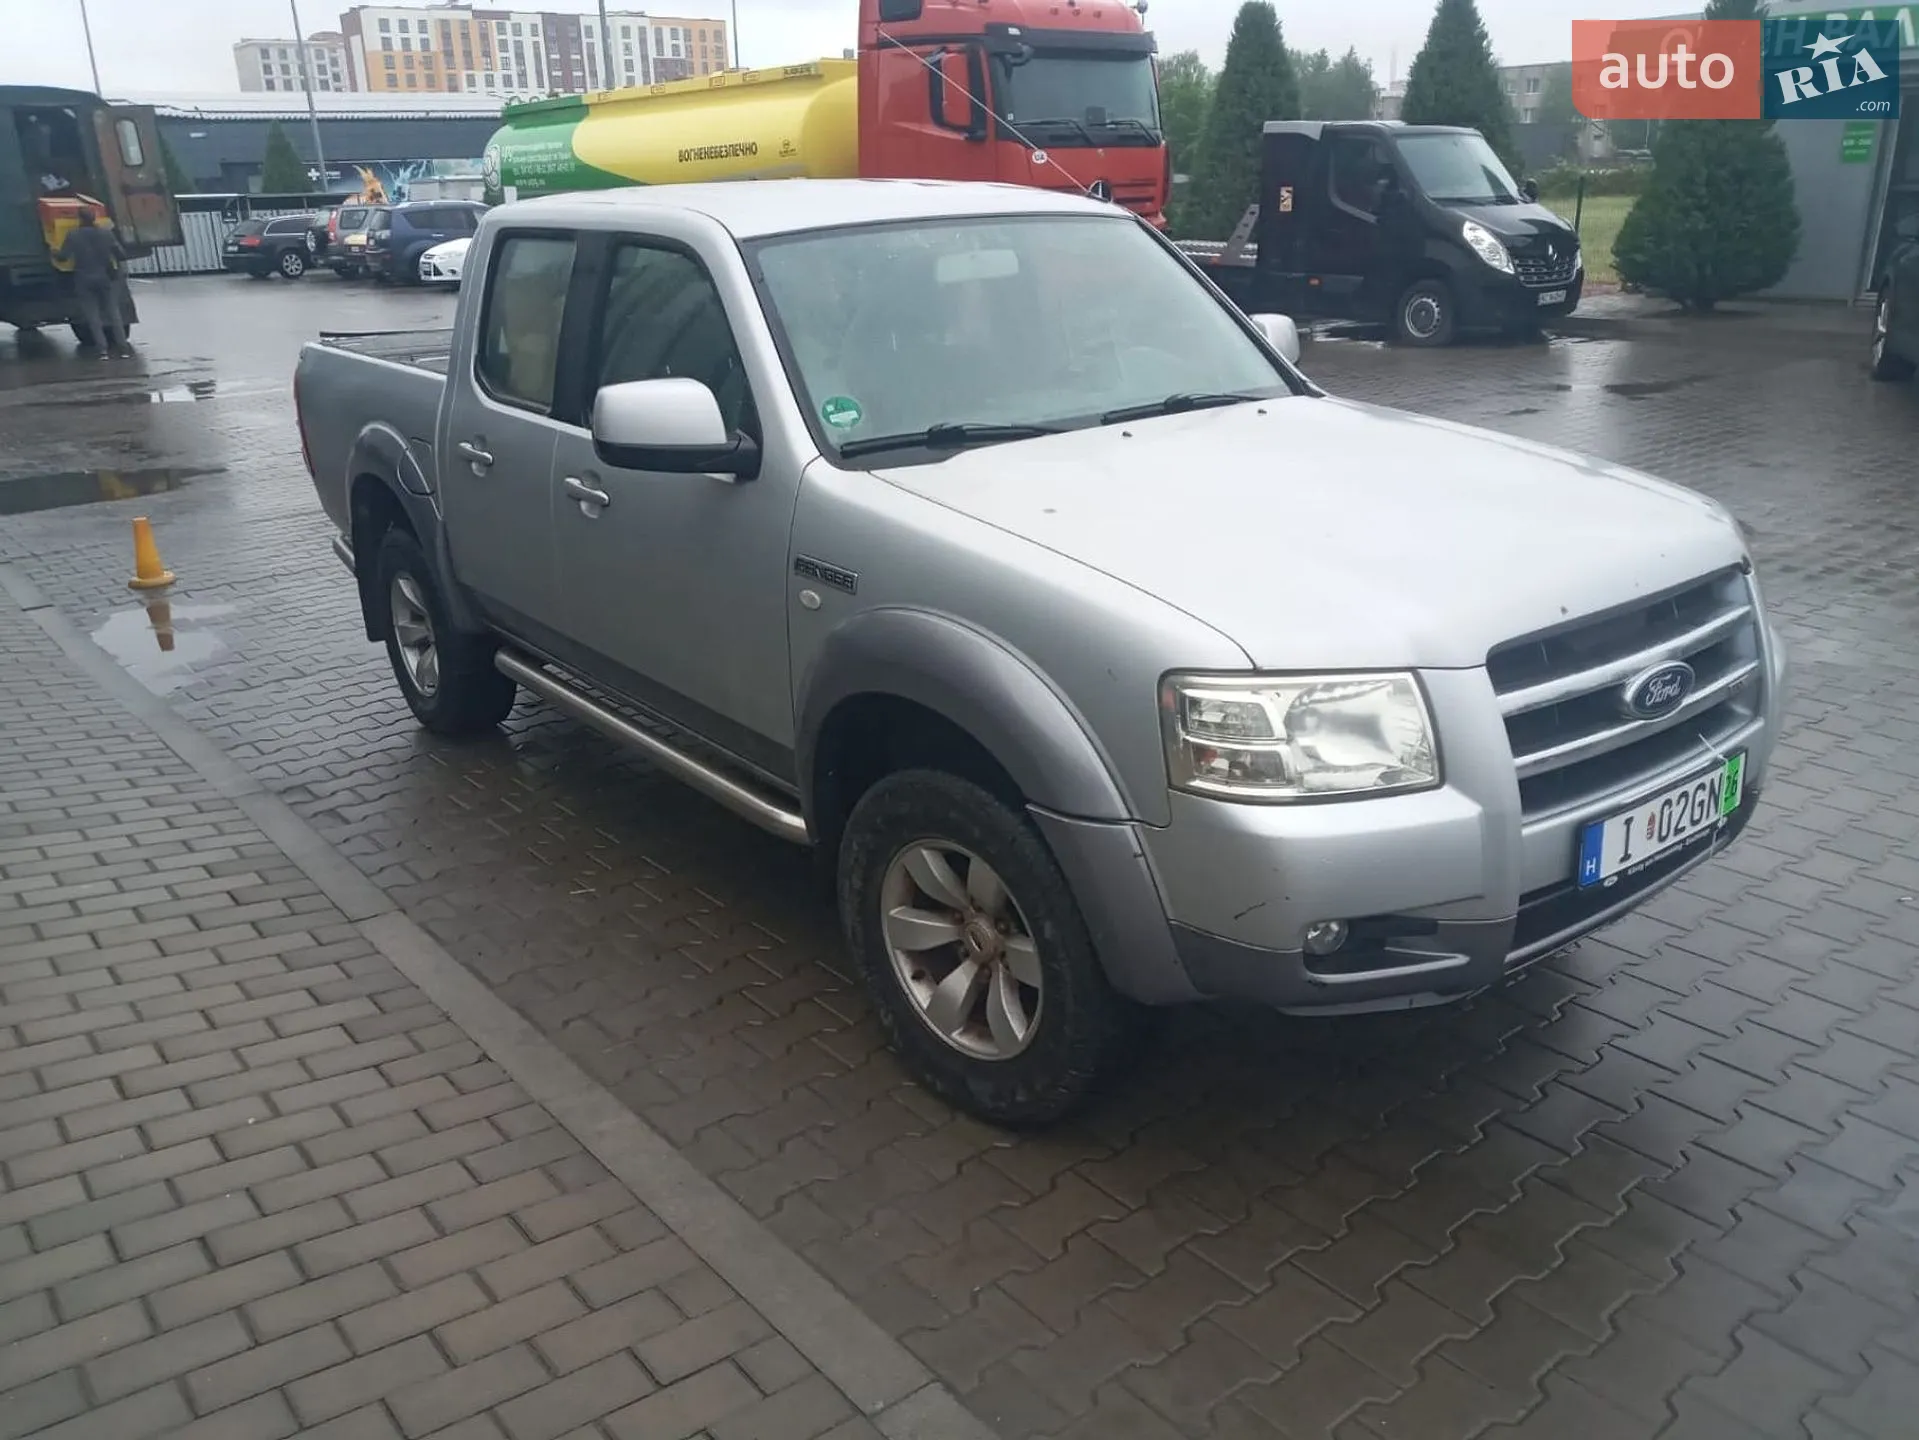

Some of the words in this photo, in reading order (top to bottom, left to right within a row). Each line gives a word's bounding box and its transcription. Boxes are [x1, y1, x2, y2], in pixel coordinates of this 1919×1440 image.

[678, 141, 758, 163] ВОГНЕНЕБЕЗПЕЧНО
[1645, 674, 1682, 706] Ford
[1585, 857, 1597, 876] H
